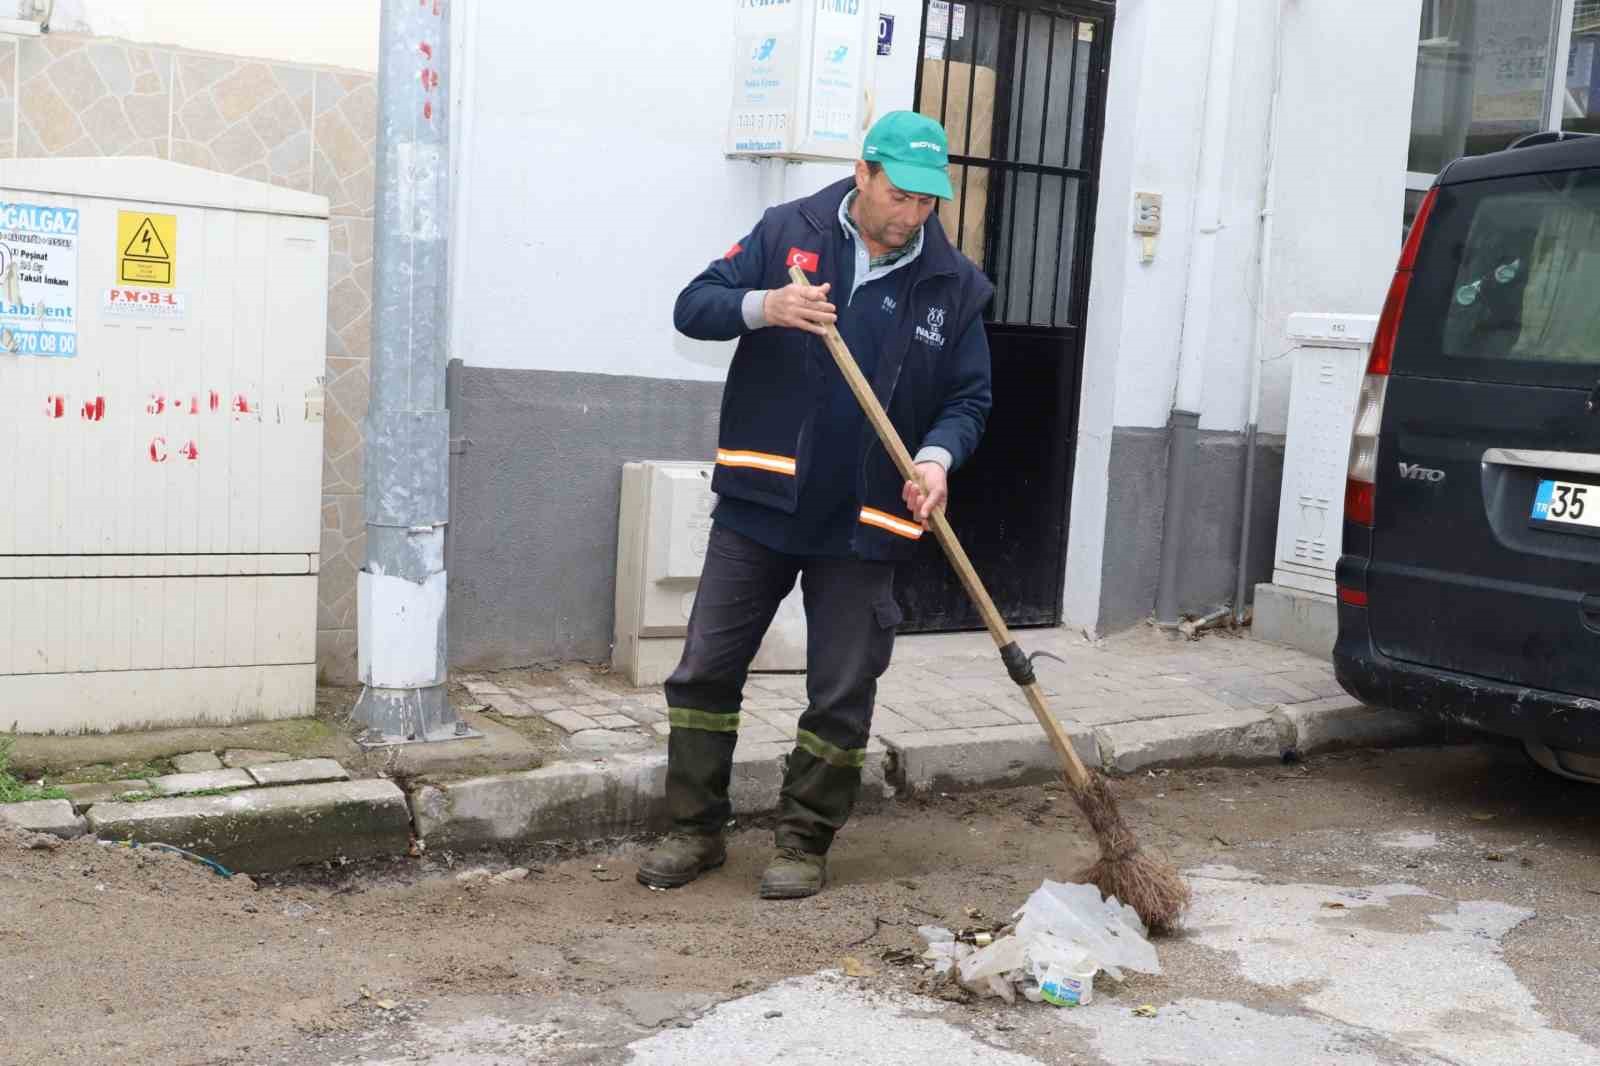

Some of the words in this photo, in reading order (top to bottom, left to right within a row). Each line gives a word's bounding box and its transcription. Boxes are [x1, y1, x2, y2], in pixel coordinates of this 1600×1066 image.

[20, 249, 48, 260] Peşinat
[20, 273, 42, 283] Taksit
[0, 302, 72, 317] Labient
[40, 333, 56, 352] 08
[60, 335, 74, 353] 00
[1551, 485, 1588, 520] 35
